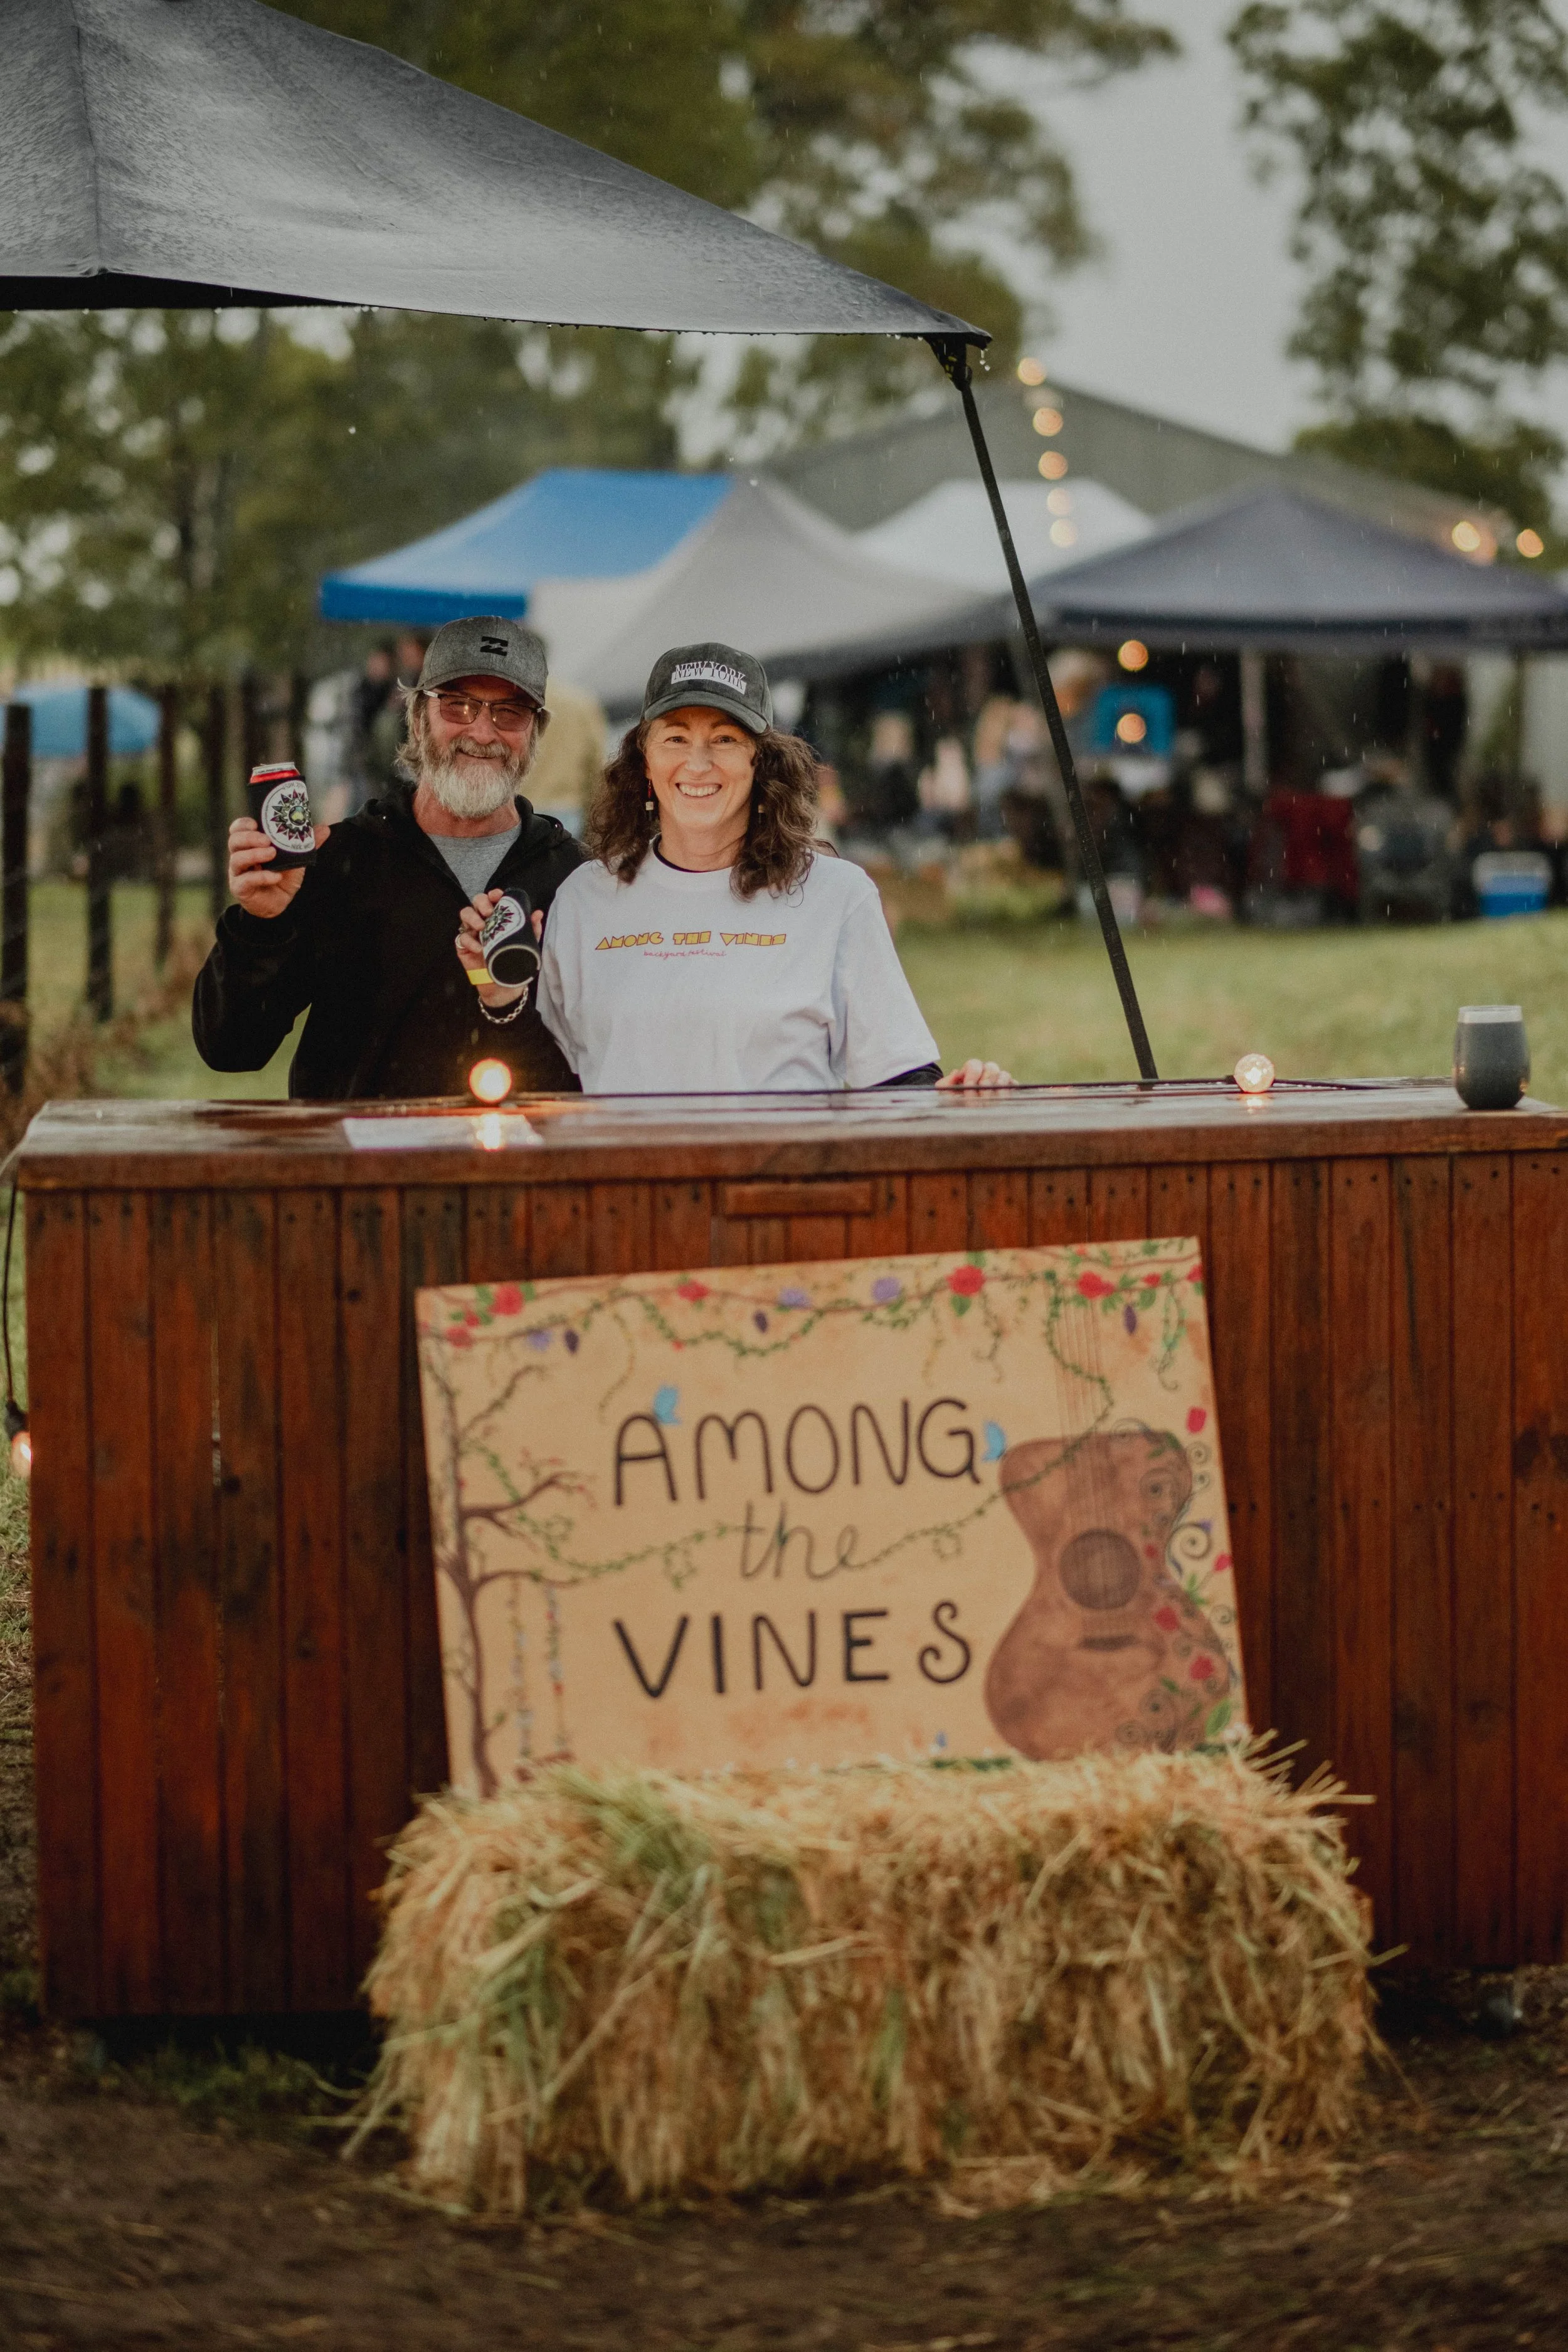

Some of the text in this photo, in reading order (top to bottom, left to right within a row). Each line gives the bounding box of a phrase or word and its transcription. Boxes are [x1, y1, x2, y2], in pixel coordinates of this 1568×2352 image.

[674, 660, 746, 690] NEW YORK
[595, 932, 664, 950] AMONG
[644, 950, 686, 960] backyard
[614, 1397, 981, 1507] AMONG
[738, 1500, 861, 1581] the
[612, 1600, 972, 1698] VINES
